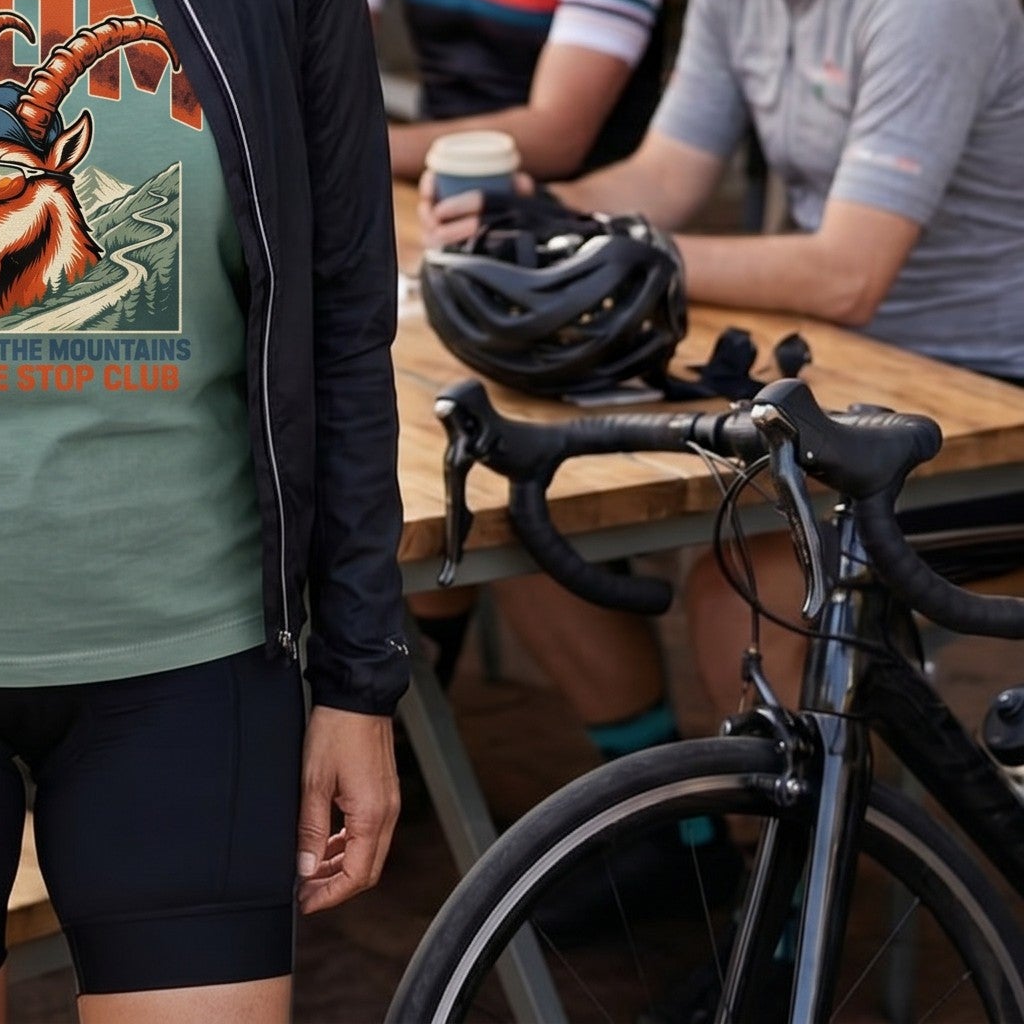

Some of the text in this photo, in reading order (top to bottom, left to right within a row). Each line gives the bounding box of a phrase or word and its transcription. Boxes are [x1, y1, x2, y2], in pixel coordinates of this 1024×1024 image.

[49, 338, 191, 361] MOUNTAINS
[16, 363, 95, 392] STOP
[103, 363, 180, 392] CLUB
